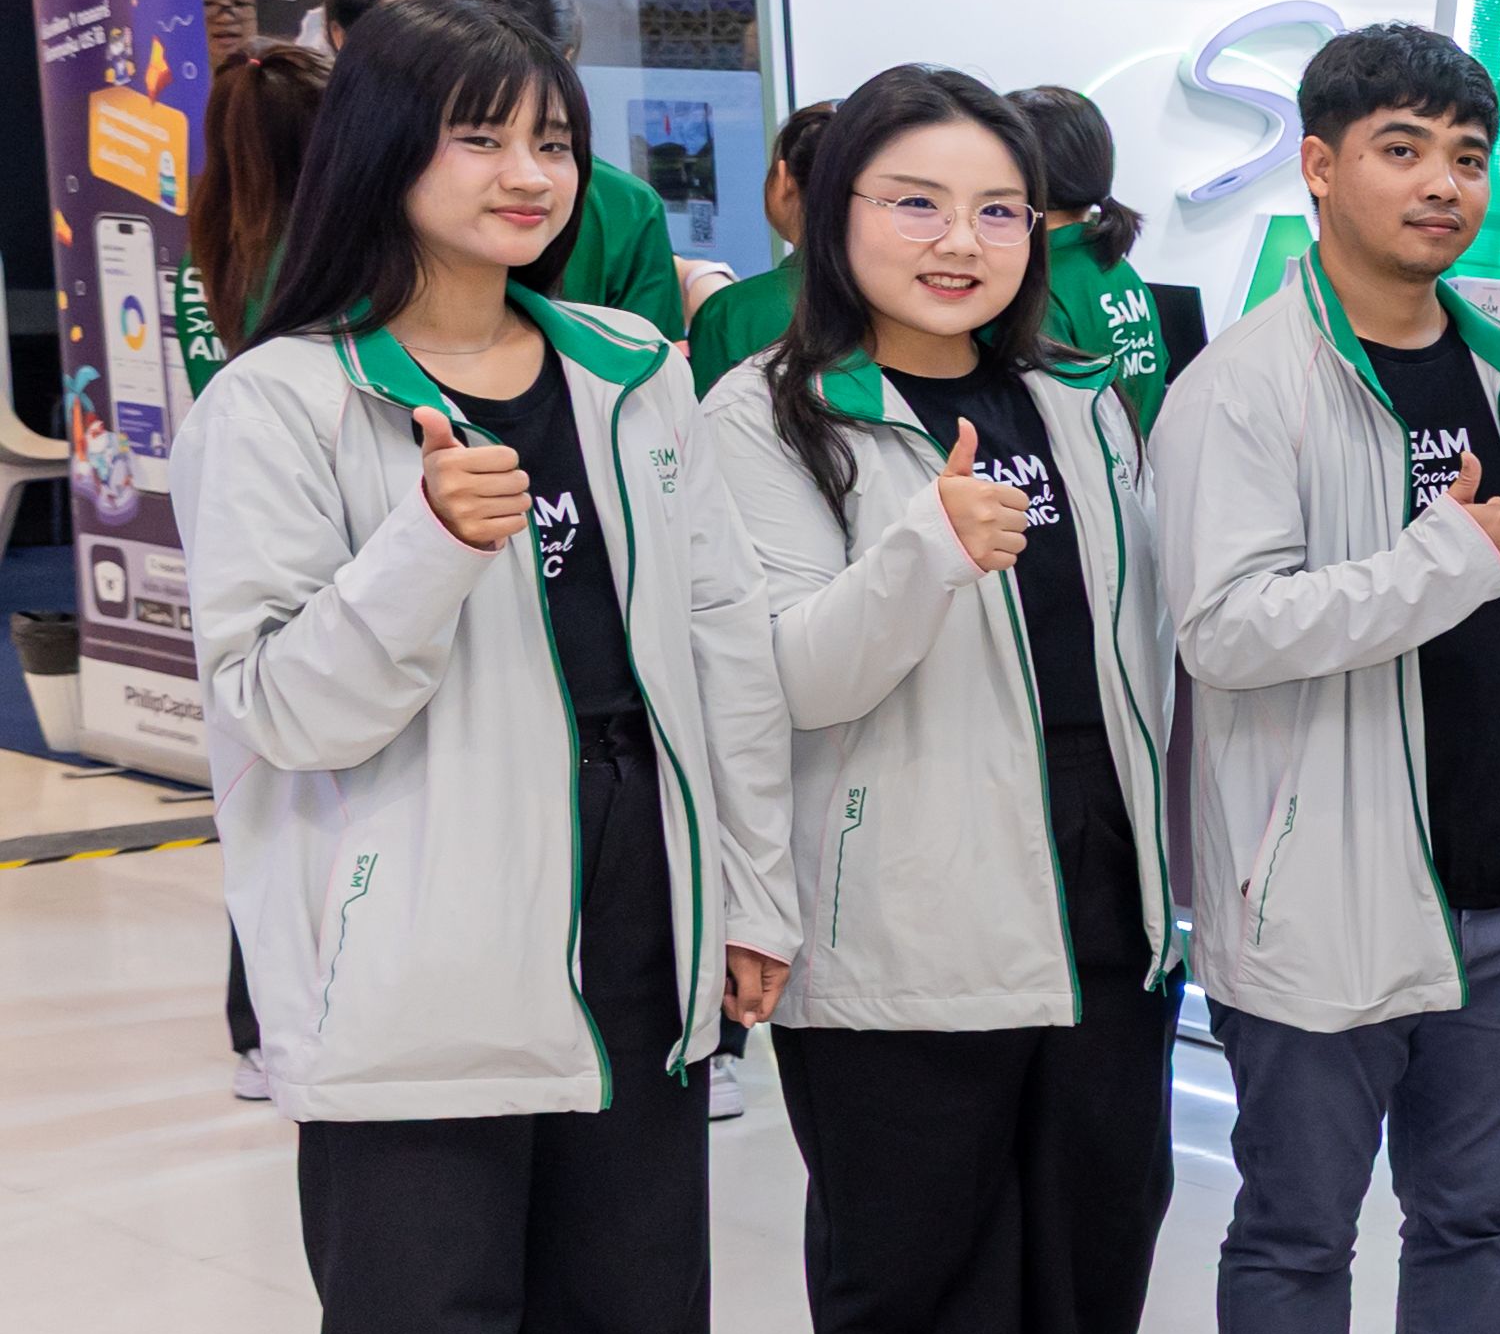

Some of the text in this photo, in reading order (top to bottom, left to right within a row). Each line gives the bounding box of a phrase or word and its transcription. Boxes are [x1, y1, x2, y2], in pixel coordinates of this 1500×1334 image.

[1411, 463, 1460, 488] Socia
[1416, 485, 1449, 508] AM
[1025, 505, 1061, 528] MC
[845, 788, 860, 819] SAM
[350, 854, 369, 887] SAM
